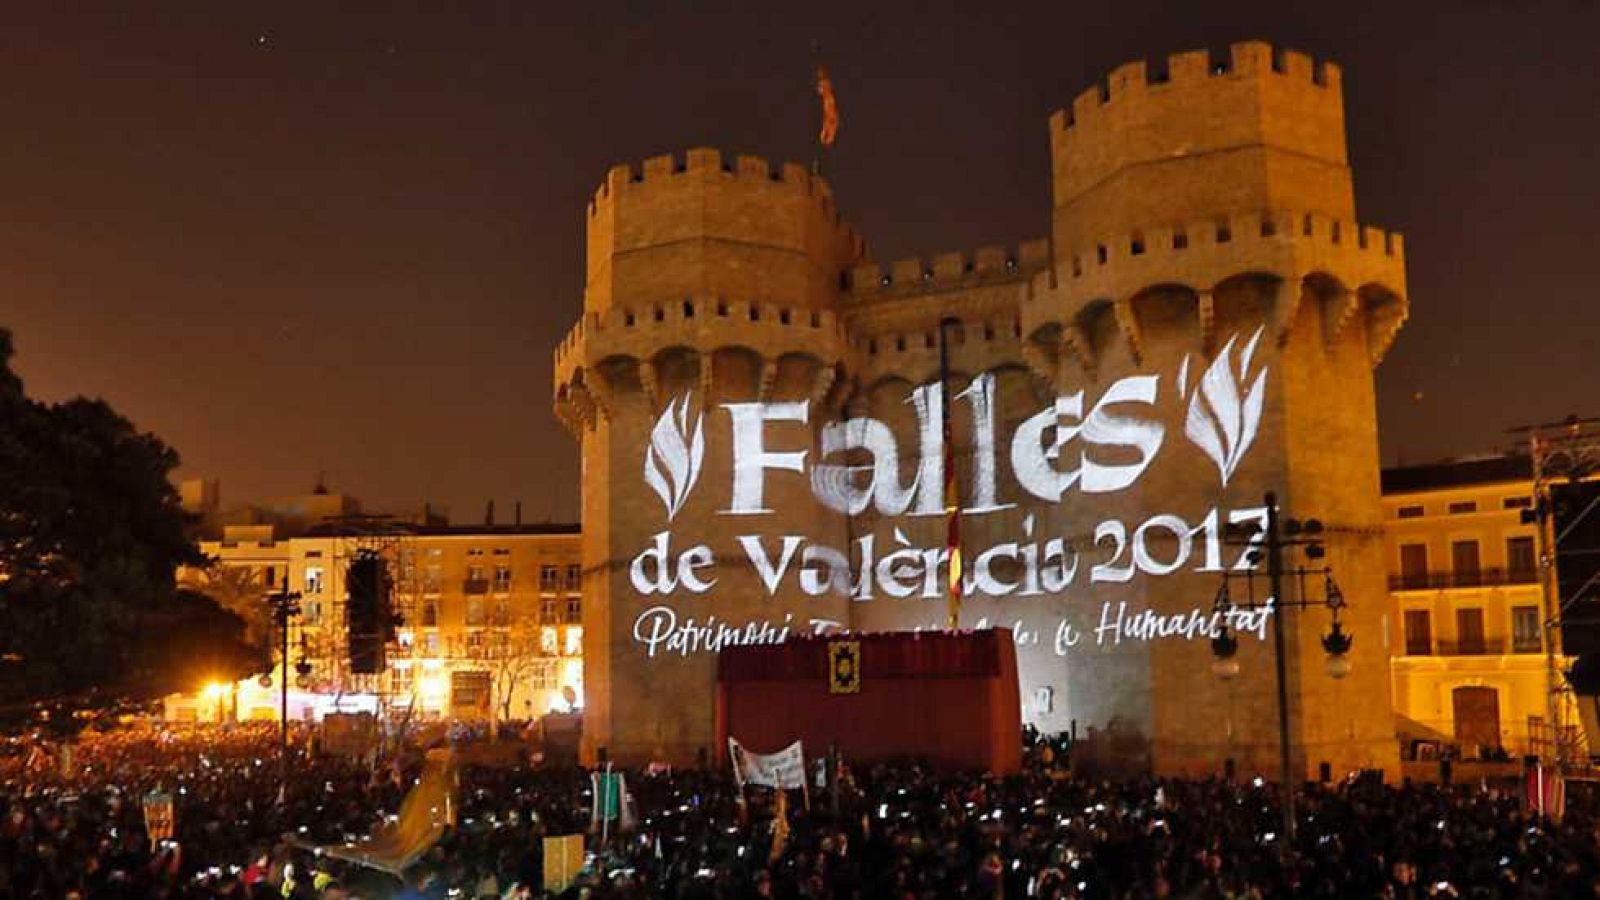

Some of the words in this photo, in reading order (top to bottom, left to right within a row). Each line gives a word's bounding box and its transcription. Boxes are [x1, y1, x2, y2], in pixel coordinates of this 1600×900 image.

[718, 373, 1165, 516] Falles
[630, 531, 718, 596] de
[736, 515, 1079, 600] València
[1091, 507, 1270, 583] 2017
